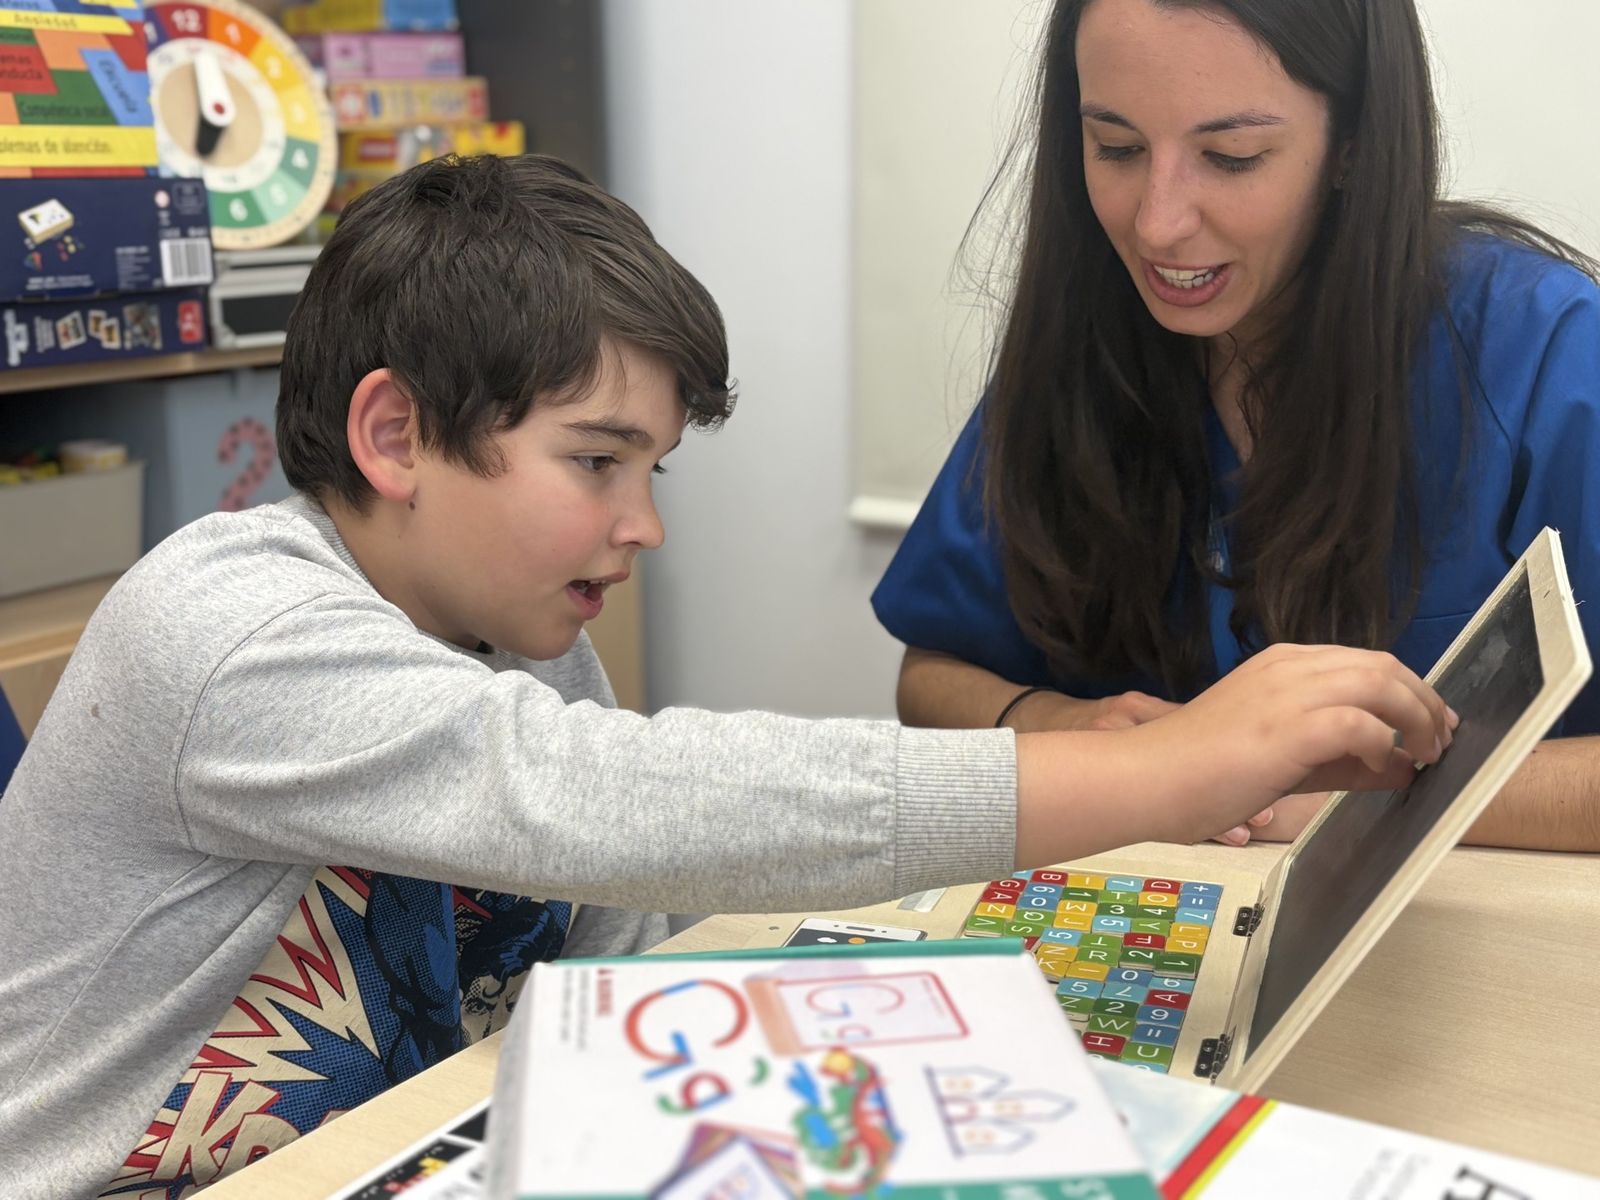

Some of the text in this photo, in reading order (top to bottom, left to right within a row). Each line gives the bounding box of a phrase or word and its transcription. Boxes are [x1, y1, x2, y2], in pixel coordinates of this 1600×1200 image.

[1000, 879, 1020, 888] G
[1151, 881, 1171, 889] D
[1111, 891, 1129, 900] T
[1110, 905, 1124, 914] 3
[1024, 911, 1044, 921] Q
[1184, 912, 1208, 920] 7
[974, 917, 996, 926] V
[1139, 922, 1160, 930] Y
[1011, 925, 1032, 933] S
[1135, 935, 1151, 944] F
[1176, 940, 1197, 948] P
[1089, 950, 1107, 960] R
[1071, 981, 1088, 992] 5
[1154, 994, 1179, 1003] A
[1105, 1001, 1125, 1013] 2
[1097, 1017, 1130, 1030] W
[1137, 1046, 1159, 1058] U
